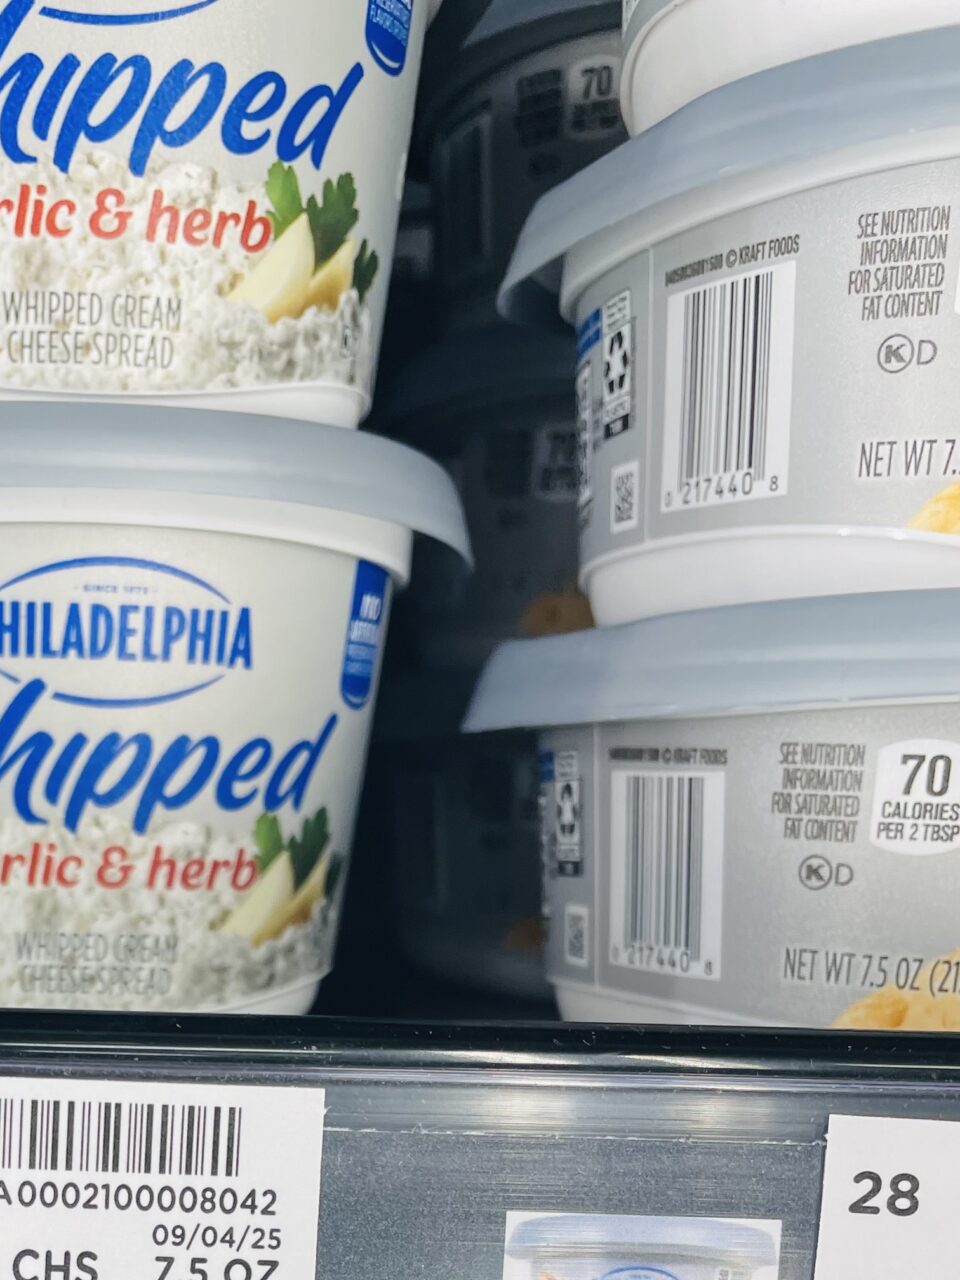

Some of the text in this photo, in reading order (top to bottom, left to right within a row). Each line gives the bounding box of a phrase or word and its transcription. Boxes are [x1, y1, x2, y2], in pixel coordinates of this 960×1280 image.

[581, 65, 612, 98] 70
[89, 190, 132, 237] &
[145, 190, 273, 253] herb
[857, 205, 951, 239] SEE NUTRITION
[739, 234, 800, 265] KRAFT FOODS
[860, 233, 948, 266] INFORMATION
[848, 262, 945, 295] FOR SATURATED
[2, 290, 182, 332] WHIPPED CREAM
[861, 290, 943, 321] FAT CONTENT
[6, 330, 174, 370] CHEESE SPREAD
[858, 440, 897, 478] NET
[904, 440, 939, 476] WT
[779, 742, 866, 767] SEE NUTRITION
[782, 768, 864, 792] INFORMATION
[901, 754, 952, 797] 70
[771, 791, 860, 818] FOR SATURATED
[881, 800, 960, 821] CALORIES
[783, 817, 858, 843] FAT CONTENT
[876, 822, 960, 842] PER 2 TBSP
[95, 846, 130, 888] &
[147, 848, 260, 891] herb
[784, 947, 923, 992] NET WT 7.5 OZ
[848, 1170, 920, 1217] 28
[152, 1223, 282, 1253] 09/04/25
